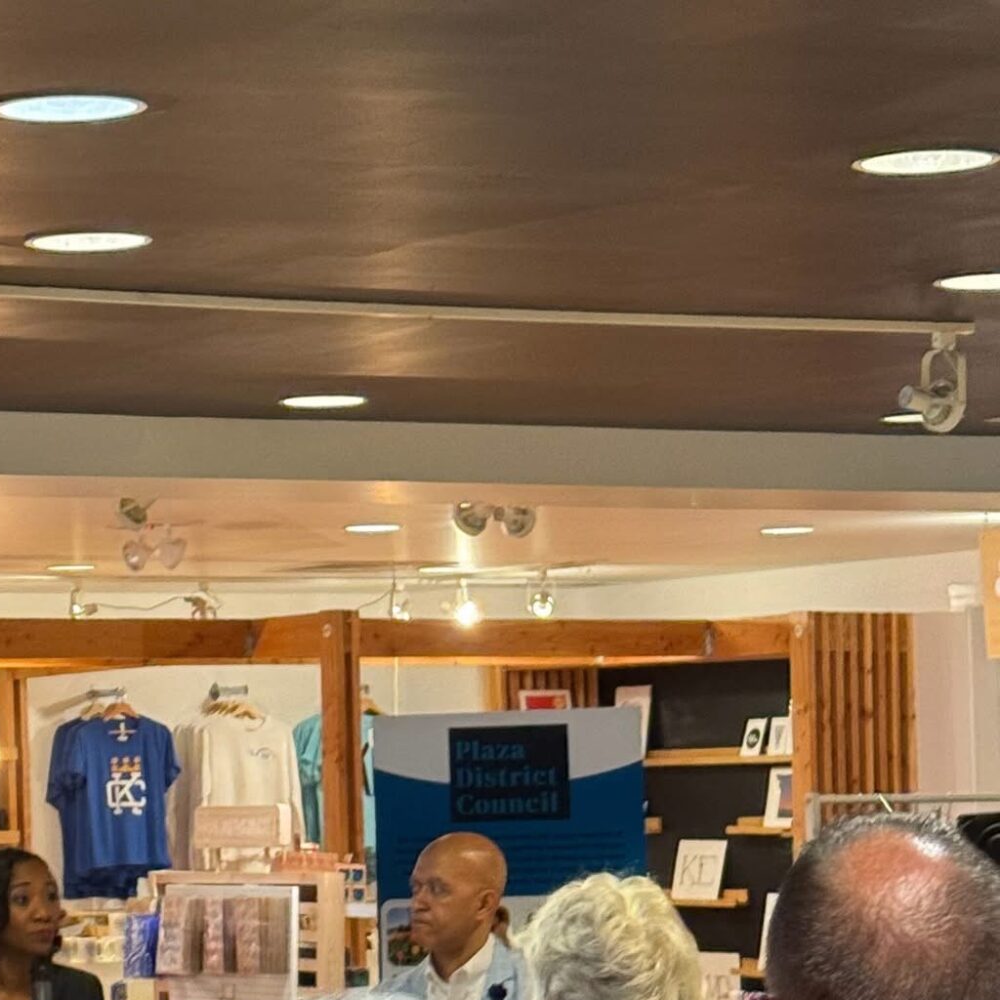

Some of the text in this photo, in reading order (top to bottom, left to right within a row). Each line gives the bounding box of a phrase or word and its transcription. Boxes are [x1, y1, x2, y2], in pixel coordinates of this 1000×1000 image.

[456, 740, 525, 760] Plaza
[456, 764, 560, 788] District
[456, 791, 559, 815] Council
